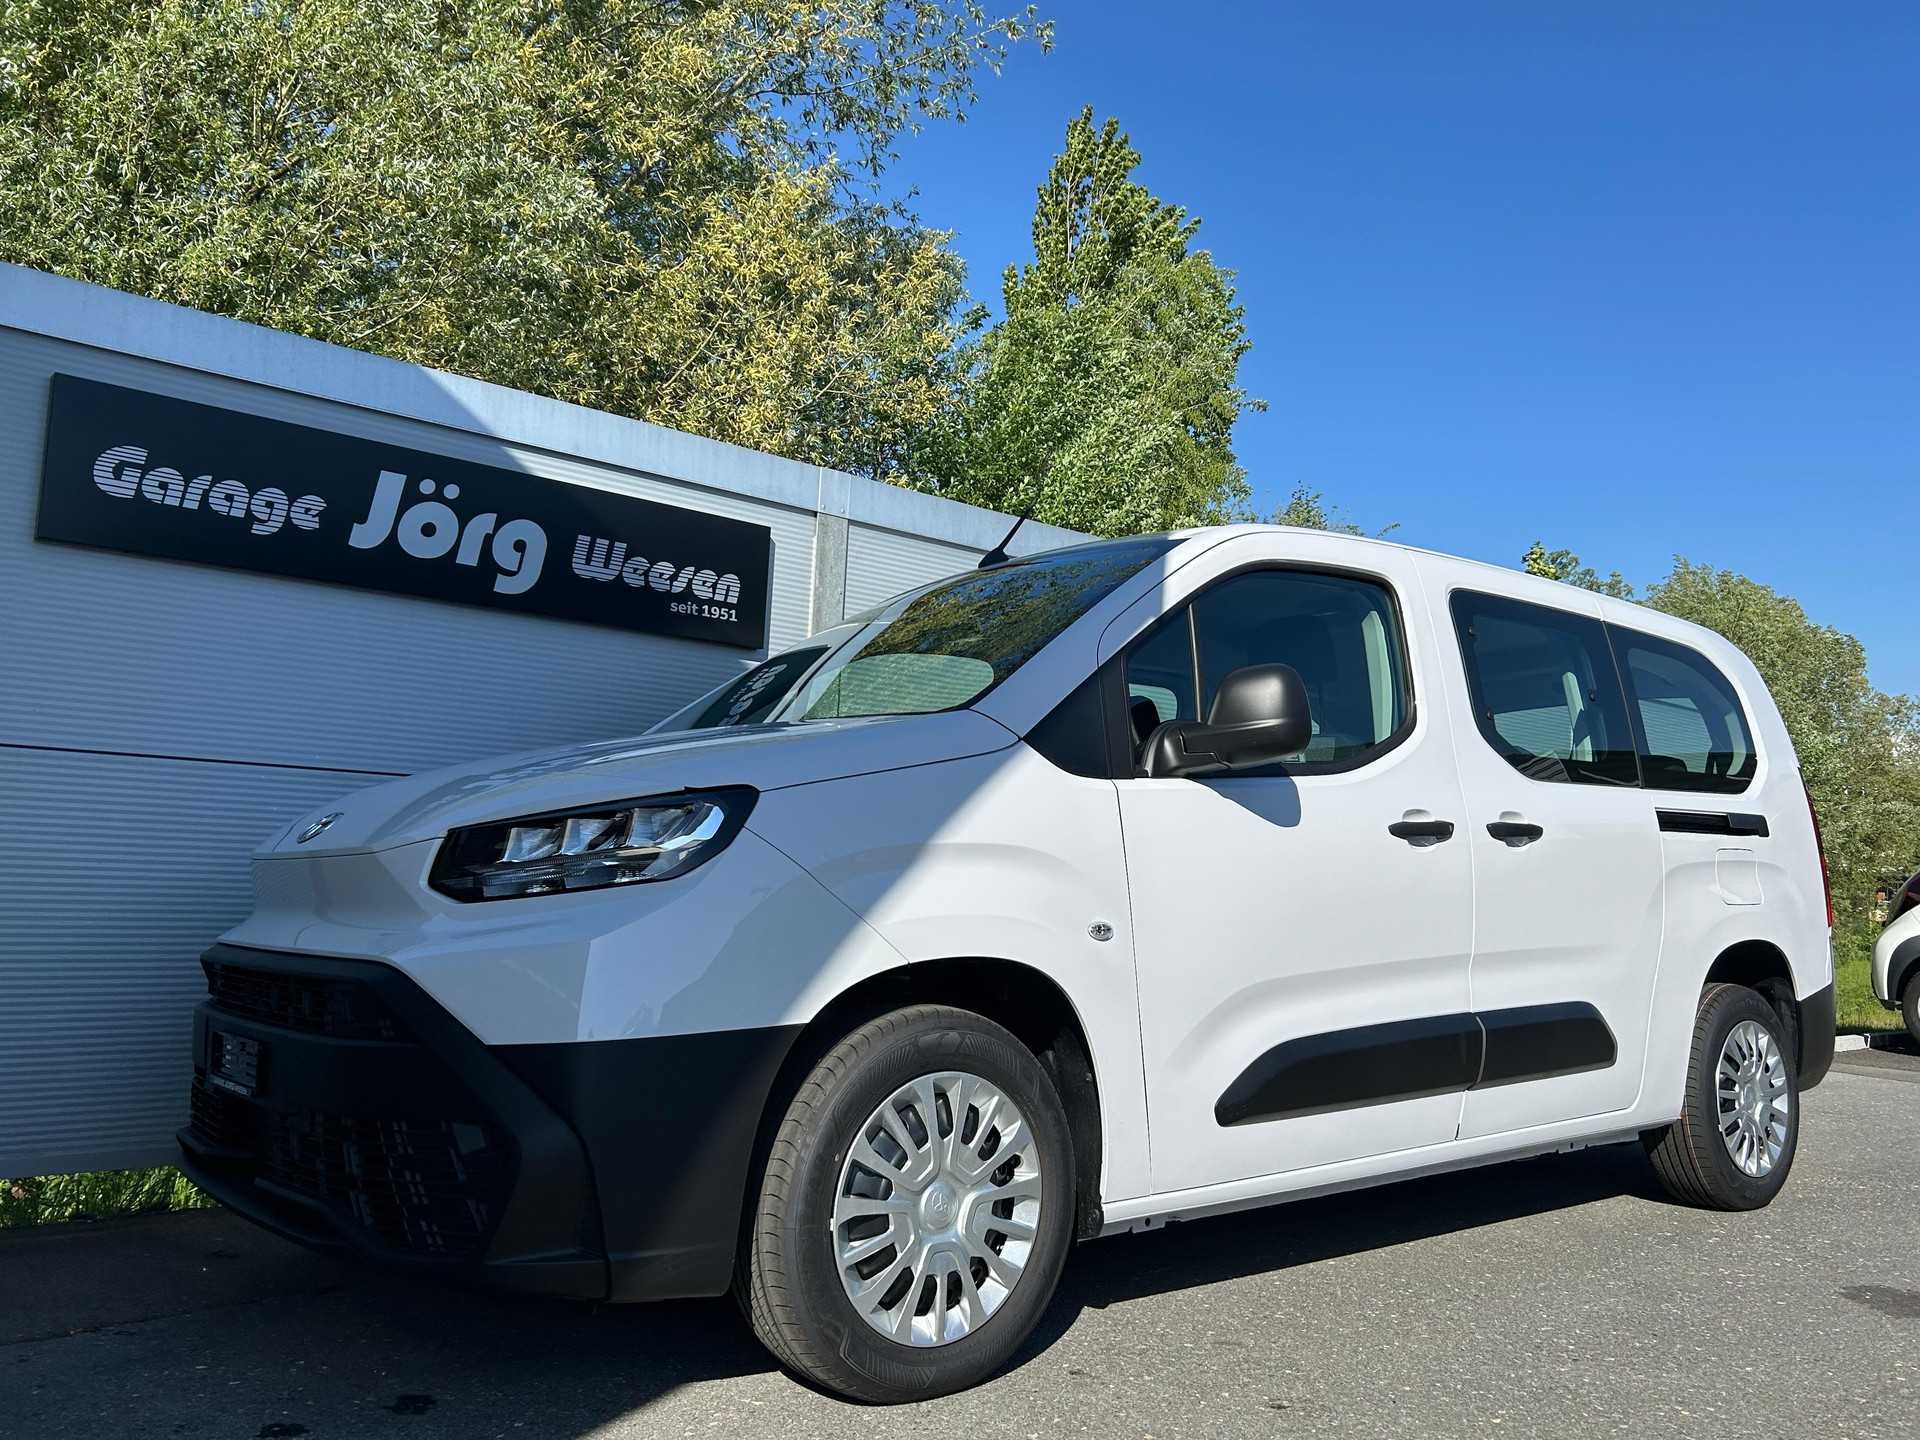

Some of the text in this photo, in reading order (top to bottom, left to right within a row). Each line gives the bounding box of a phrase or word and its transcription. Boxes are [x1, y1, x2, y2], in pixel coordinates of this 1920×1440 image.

[93, 445, 741, 604] Garage Jörg Weesen
[670, 601, 738, 622] seit 1951
